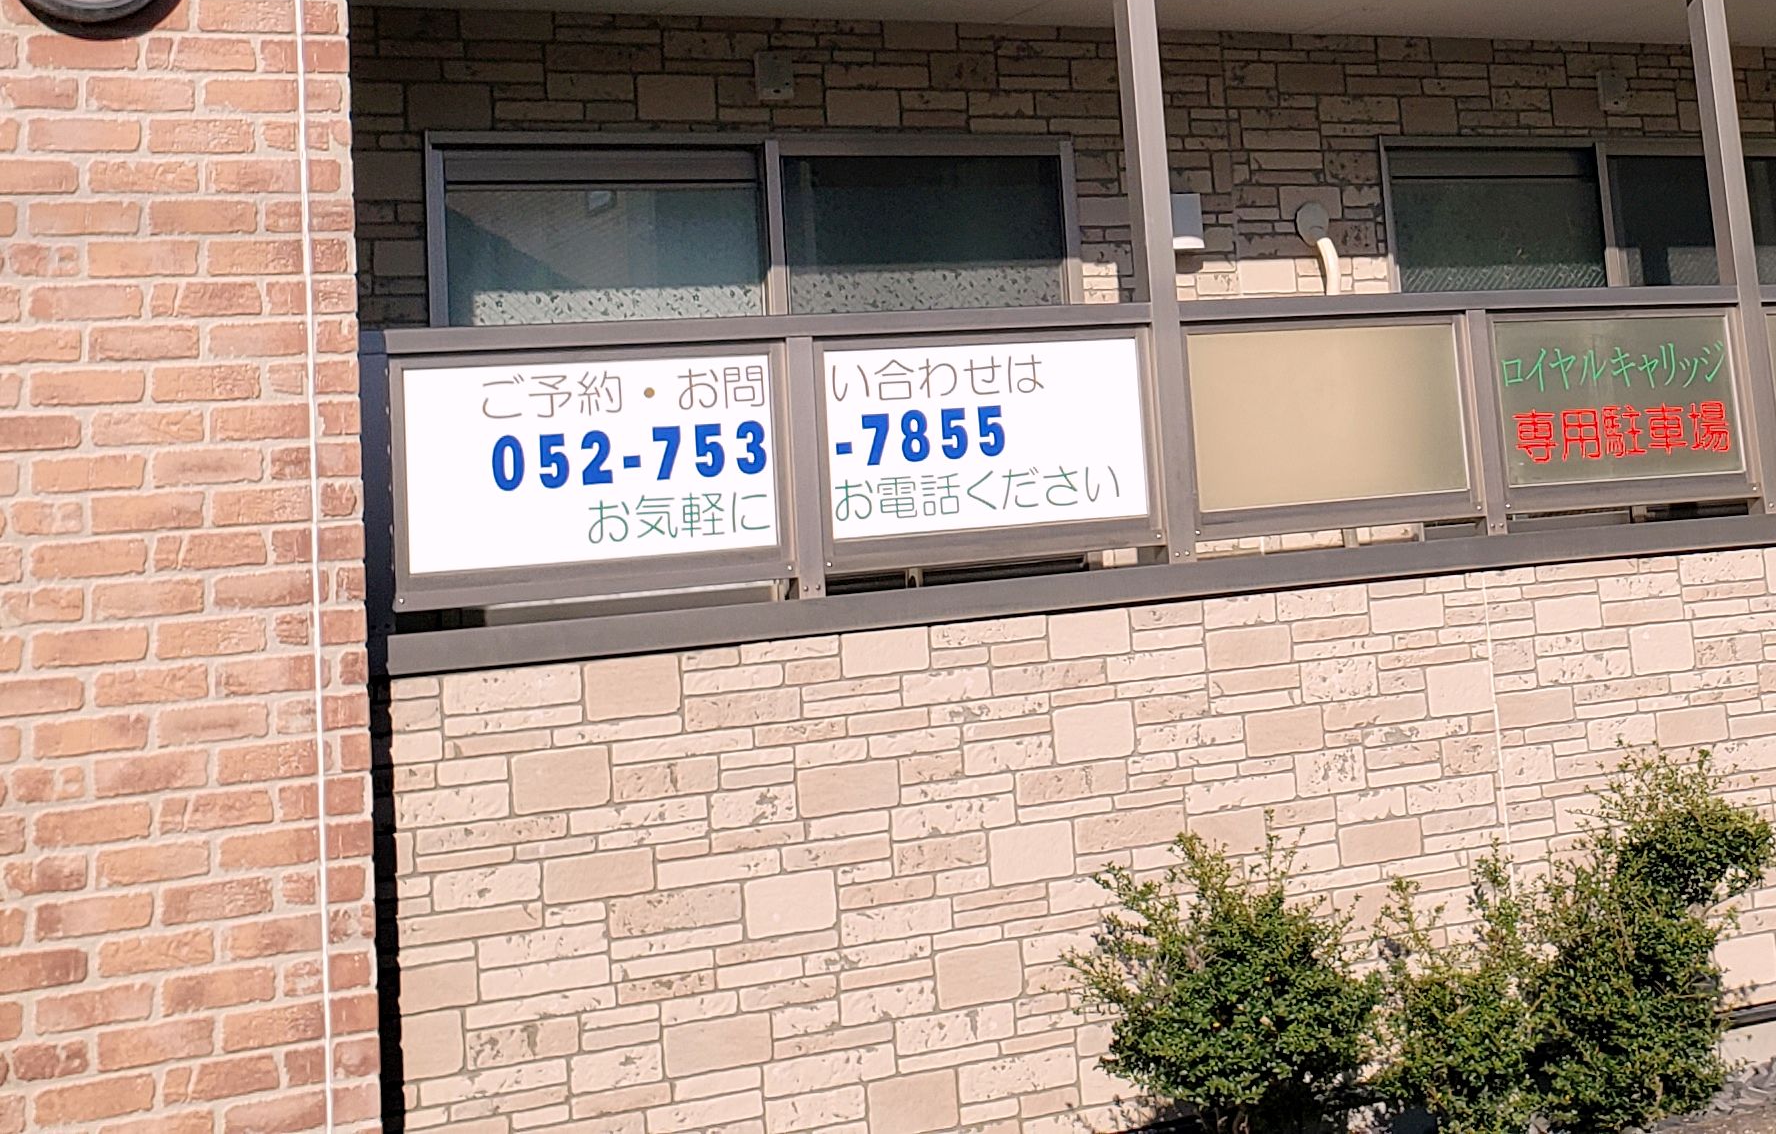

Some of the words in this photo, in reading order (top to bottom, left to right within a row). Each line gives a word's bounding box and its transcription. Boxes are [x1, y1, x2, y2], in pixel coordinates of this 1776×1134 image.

[831, 354, 1045, 402] い合わせは
[1500, 339, 1727, 393] ロイヤルキャリッジ
[491, 420, 768, 492] 052-753
[1512, 400, 1731, 464] 専用駐車場
[588, 492, 771, 544] お気軽に
[834, 465, 1121, 522] お電話ください
